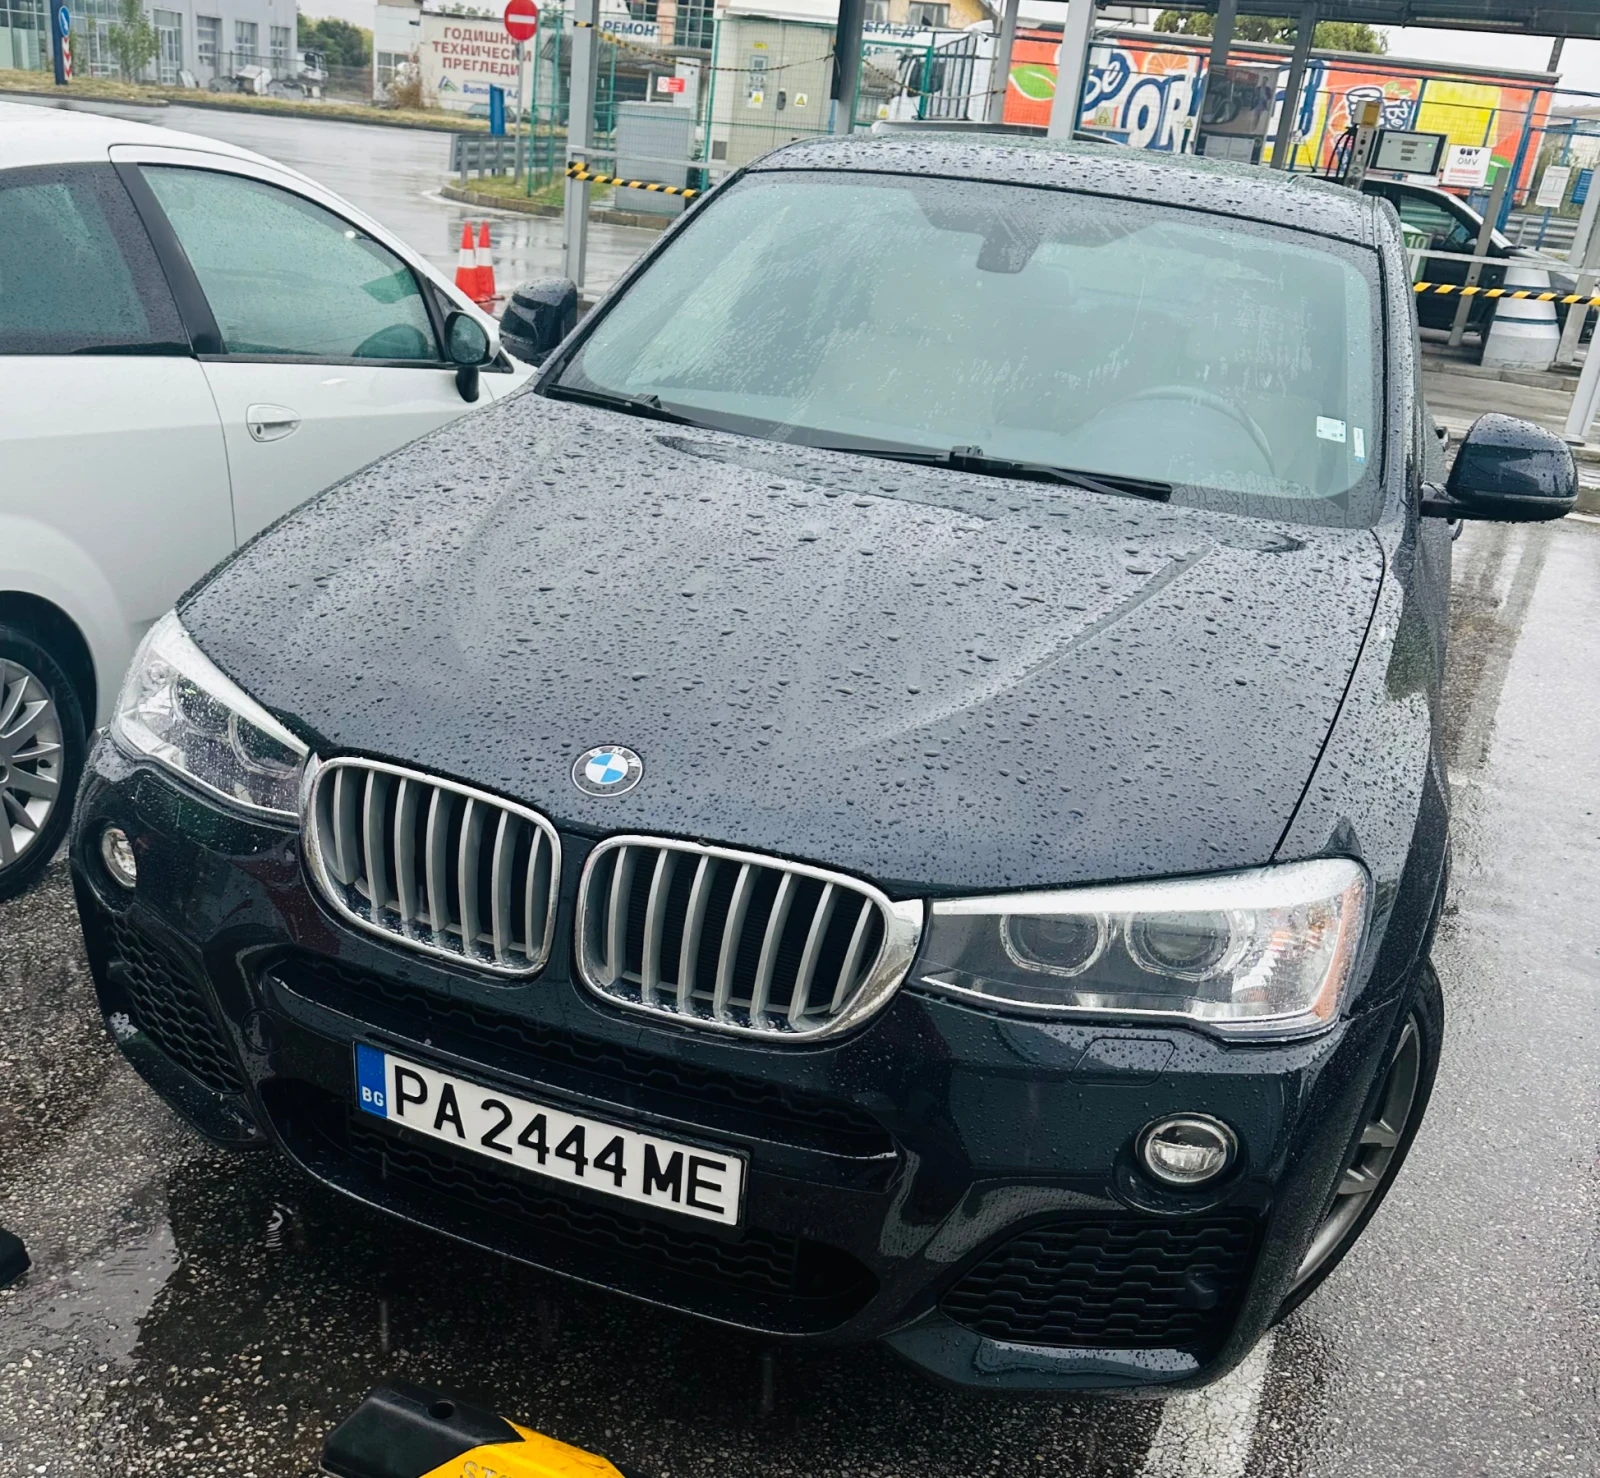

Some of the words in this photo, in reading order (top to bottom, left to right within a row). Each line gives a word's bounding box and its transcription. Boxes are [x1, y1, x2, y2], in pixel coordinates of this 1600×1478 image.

[444, 27, 518, 46] ГОДИШН
[603, 21, 660, 36] РЕМОН
[442, 57, 520, 77] ПРЕГЛЕДИ
[1457, 157, 1478, 165] OMV
[1407, 235, 1427, 249] 10
[588, 746, 640, 767] BMW
[361, 1086, 384, 1107] BG
[394, 1064, 466, 1139] PA
[480, 1098, 627, 1188] 2444
[642, 1143, 727, 1215] ME
